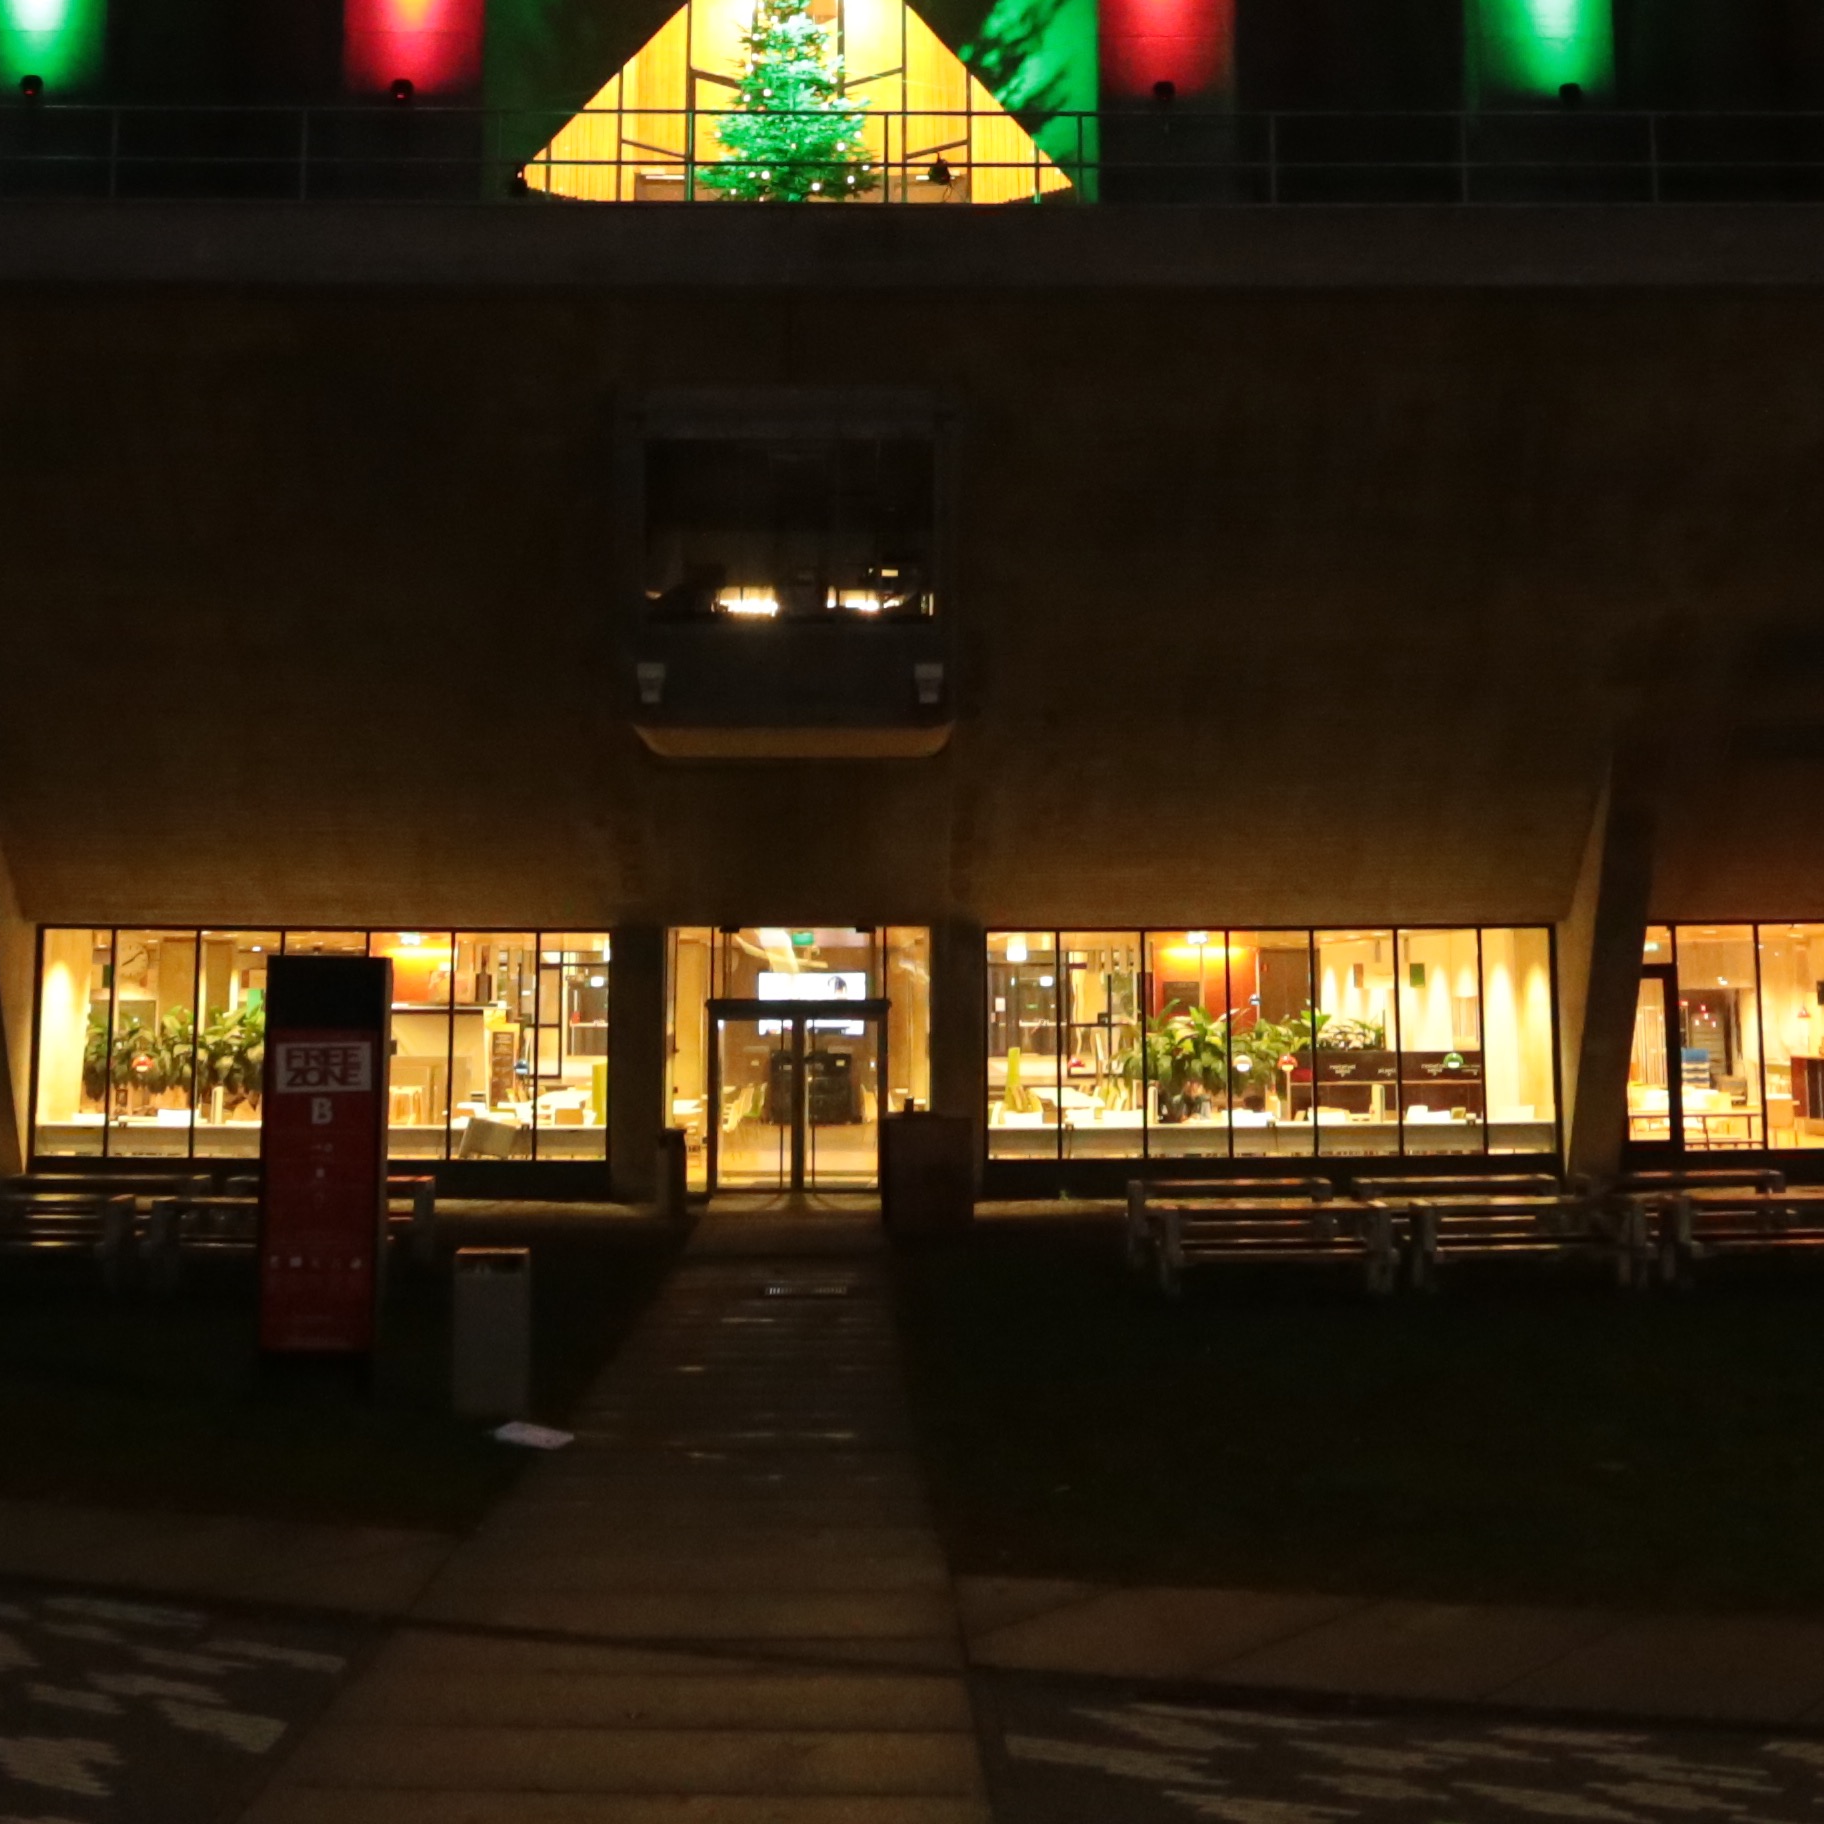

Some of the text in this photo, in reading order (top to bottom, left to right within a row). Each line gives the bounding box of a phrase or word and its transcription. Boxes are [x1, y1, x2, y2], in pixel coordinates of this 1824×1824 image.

[286, 1046, 361, 1068] FREE
[286, 1065, 361, 1086] ZONE
[311, 1096, 334, 1124] B
